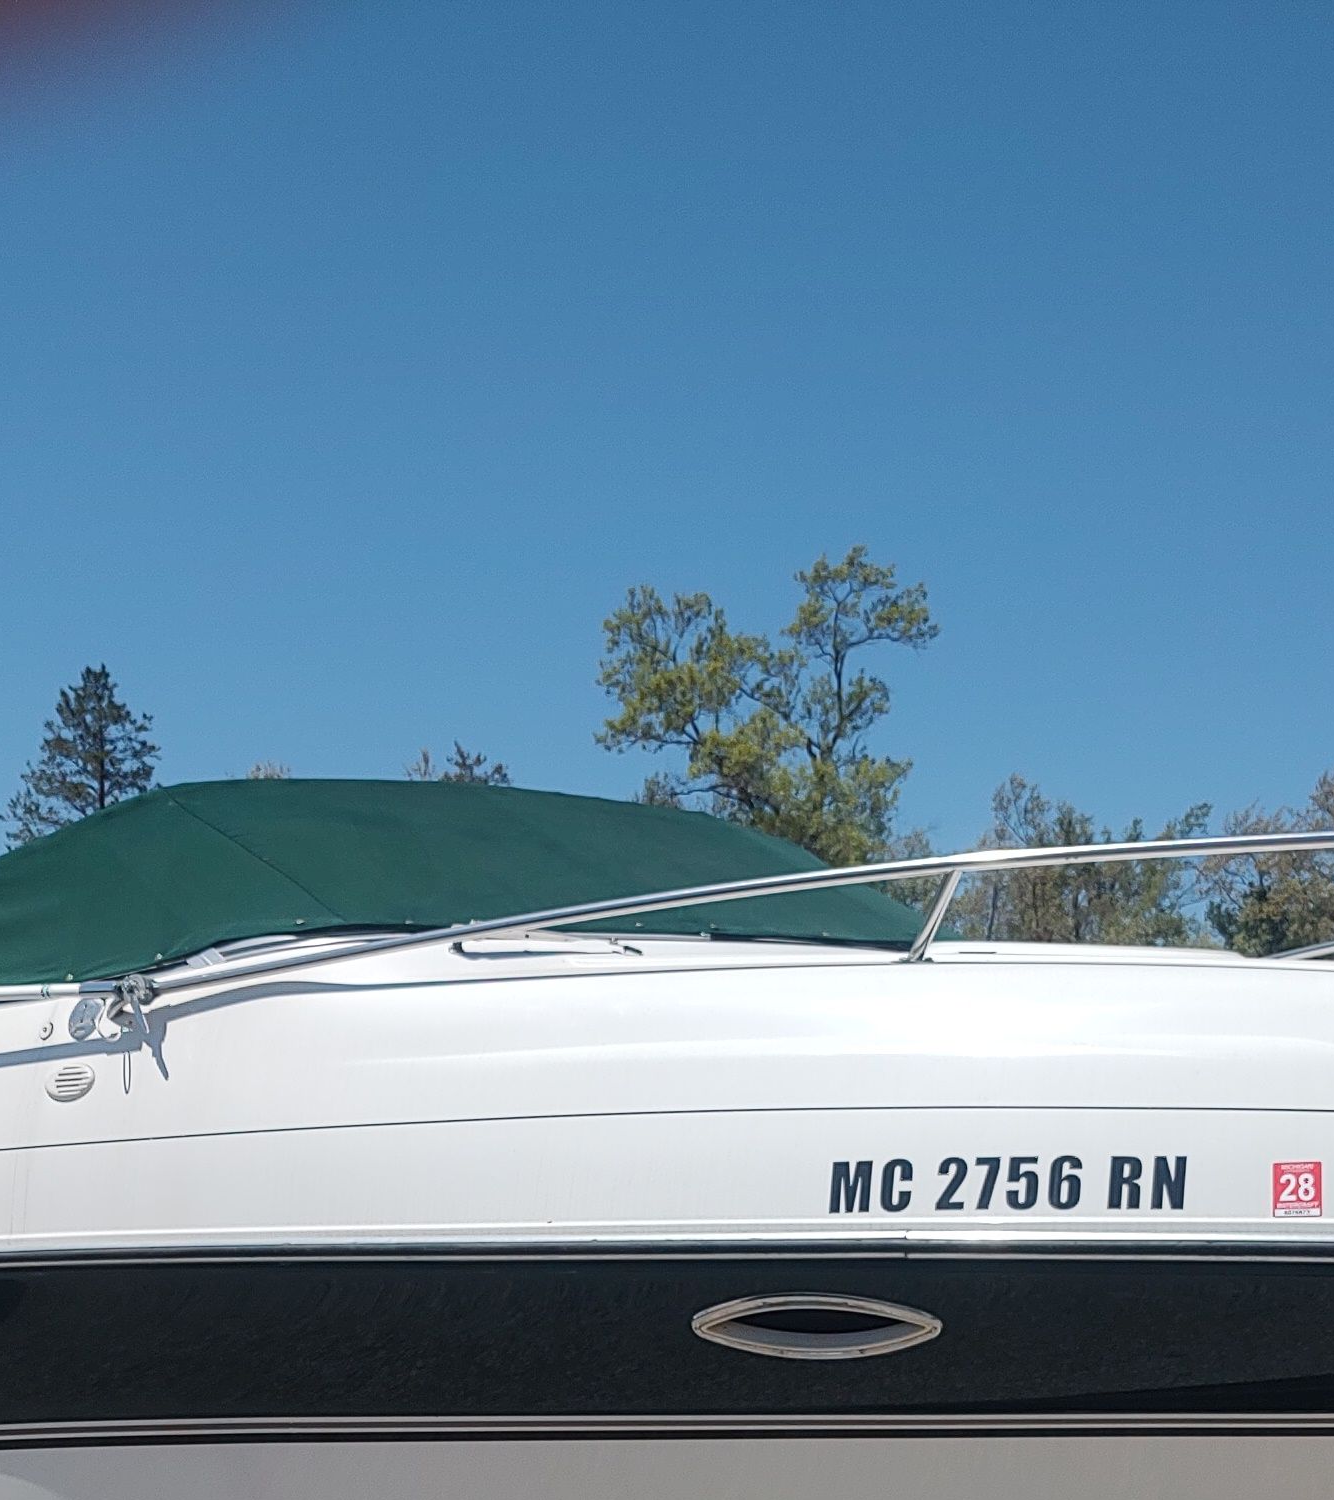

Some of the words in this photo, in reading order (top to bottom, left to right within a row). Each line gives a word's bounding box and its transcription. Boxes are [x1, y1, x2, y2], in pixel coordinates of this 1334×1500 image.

[828, 1158, 914, 1214] MC
[934, 1154, 1084, 1211] 2756
[1106, 1155, 1188, 1211] RN
[1278, 1172, 1316, 1202] 28
